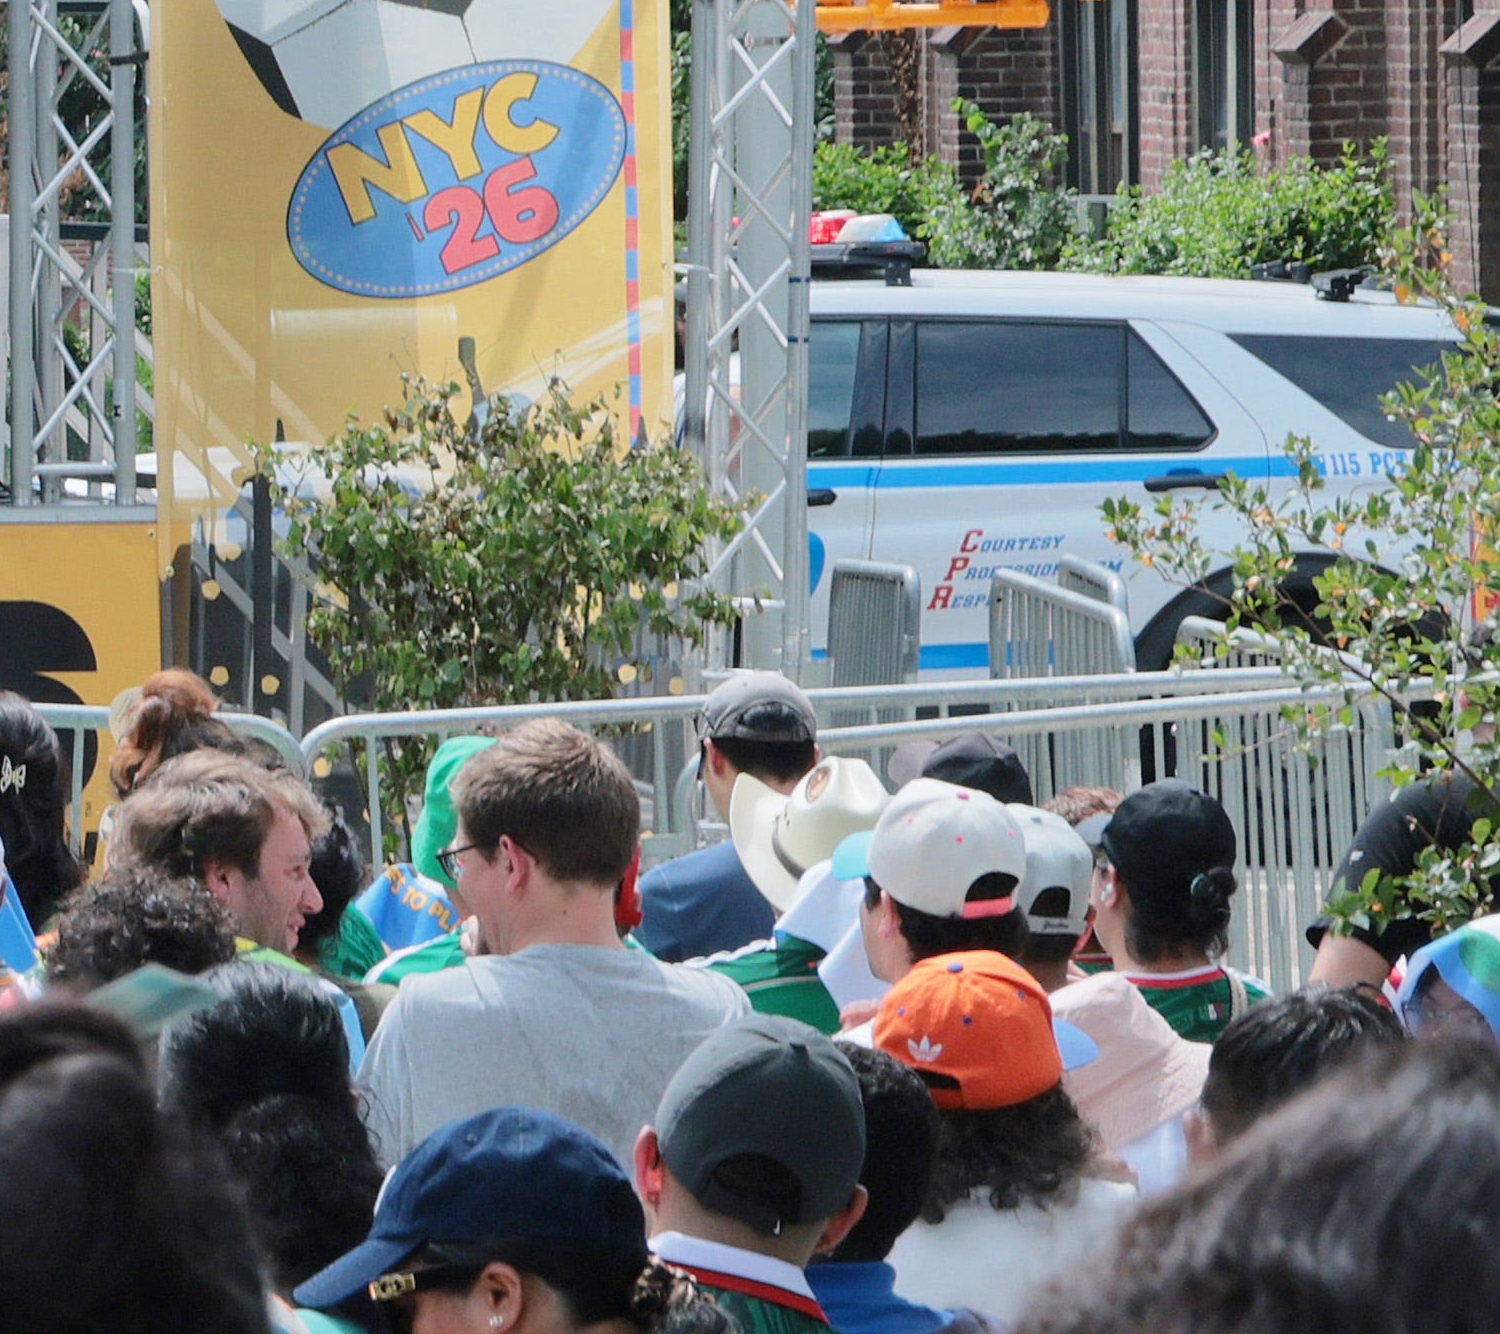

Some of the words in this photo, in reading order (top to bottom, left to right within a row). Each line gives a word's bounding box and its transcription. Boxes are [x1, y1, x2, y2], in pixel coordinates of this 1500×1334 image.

[326, 72, 561, 227] NYC
[1326, 452, 1361, 476] 115
[1368, 451, 1408, 476] PCT
[402, 885, 428, 911] TO
